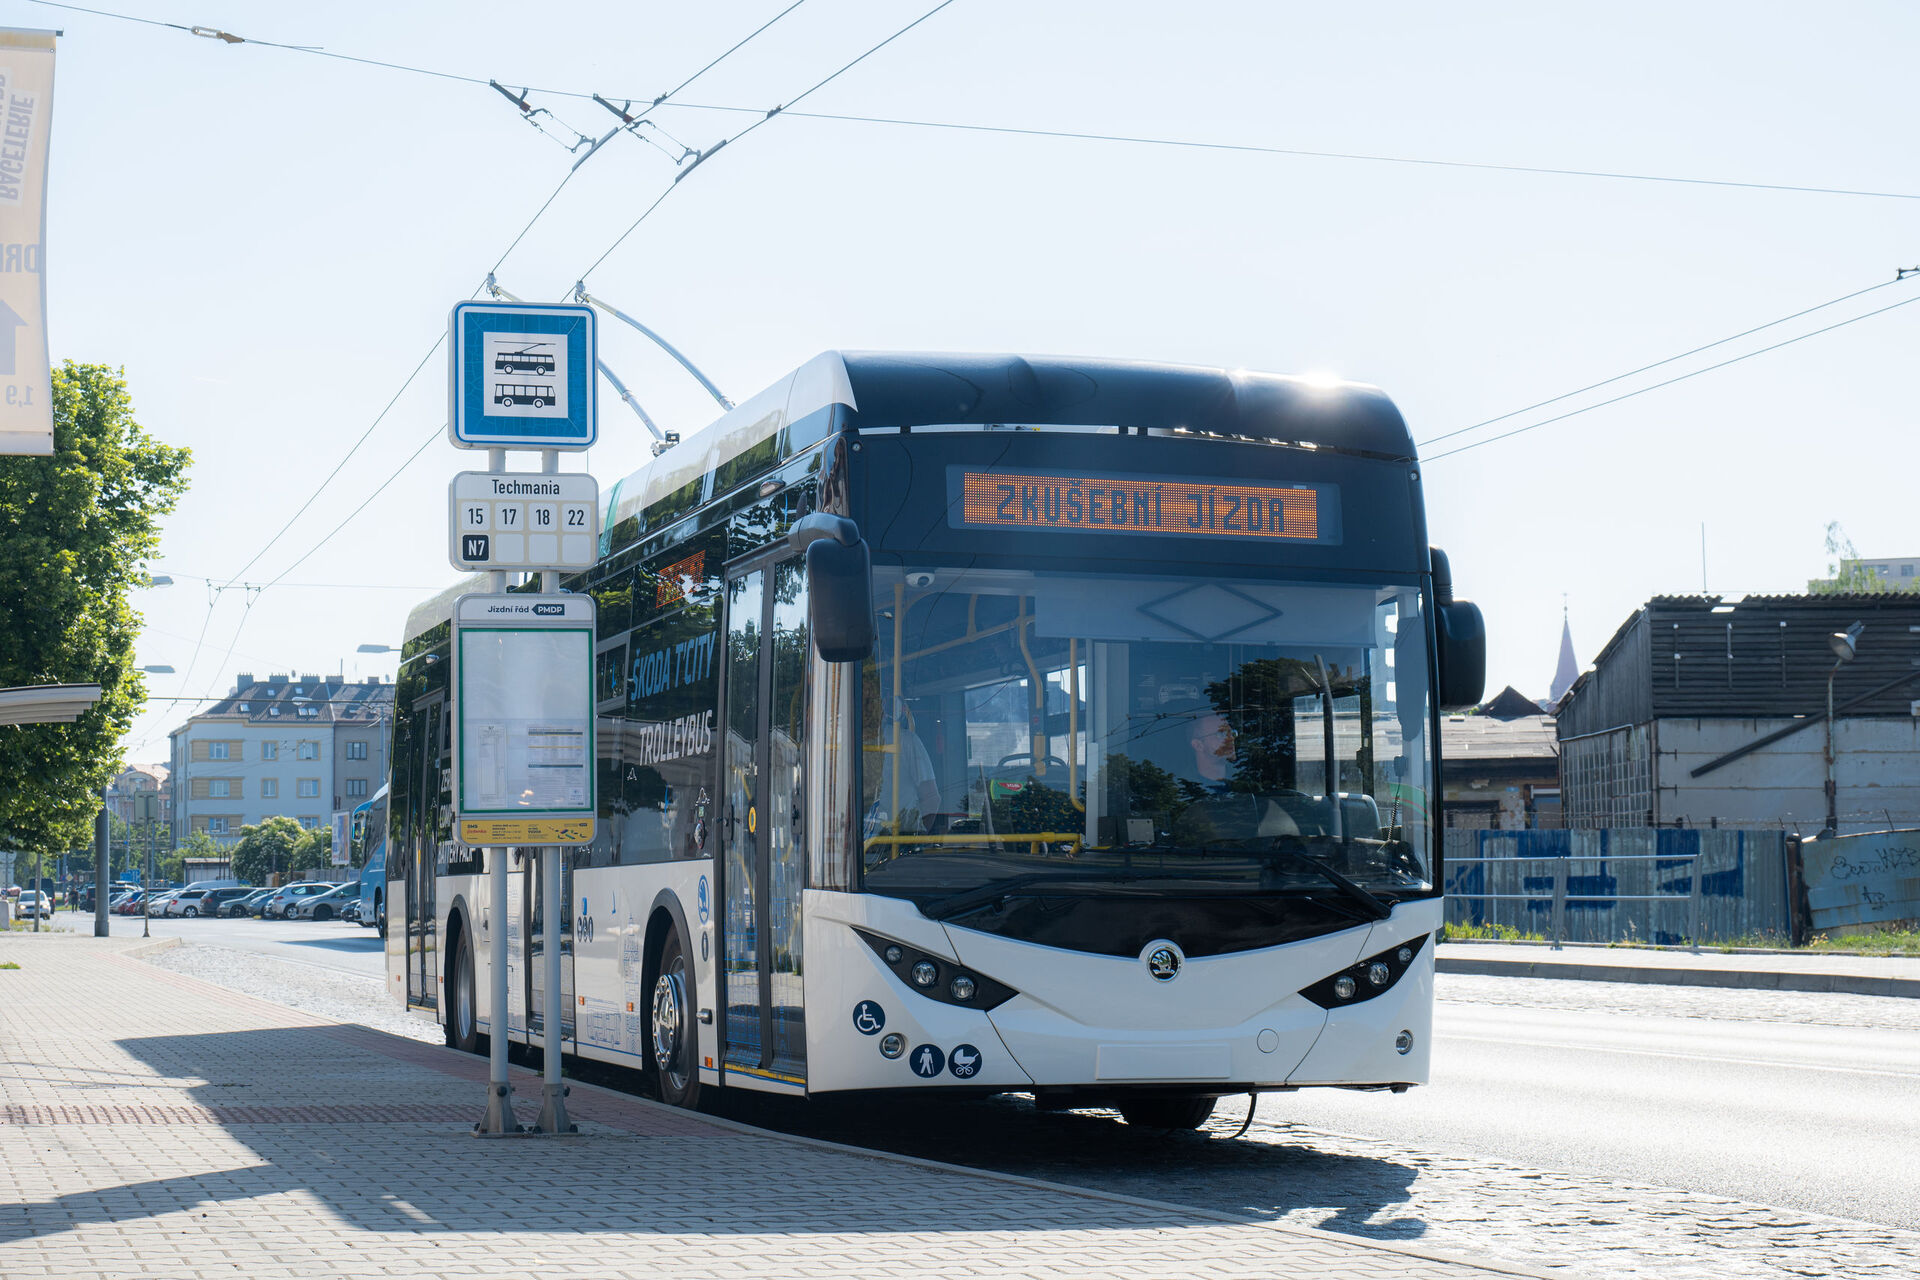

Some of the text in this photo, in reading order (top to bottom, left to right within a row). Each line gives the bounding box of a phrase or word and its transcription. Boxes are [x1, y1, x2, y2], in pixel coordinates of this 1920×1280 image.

[492, 479, 560, 496] Techmania
[996, 480, 1284, 532] ZKUŠEBNÍ JÍZDA
[468, 508, 585, 526] 15 17 18 22
[468, 540, 486, 557] N7
[487, 604, 530, 613] Jízdní řád
[537, 606, 563, 614] PMDP
[630, 647, 671, 701] ŠKODA
[639, 709, 713, 766] TROLLEYBUS
